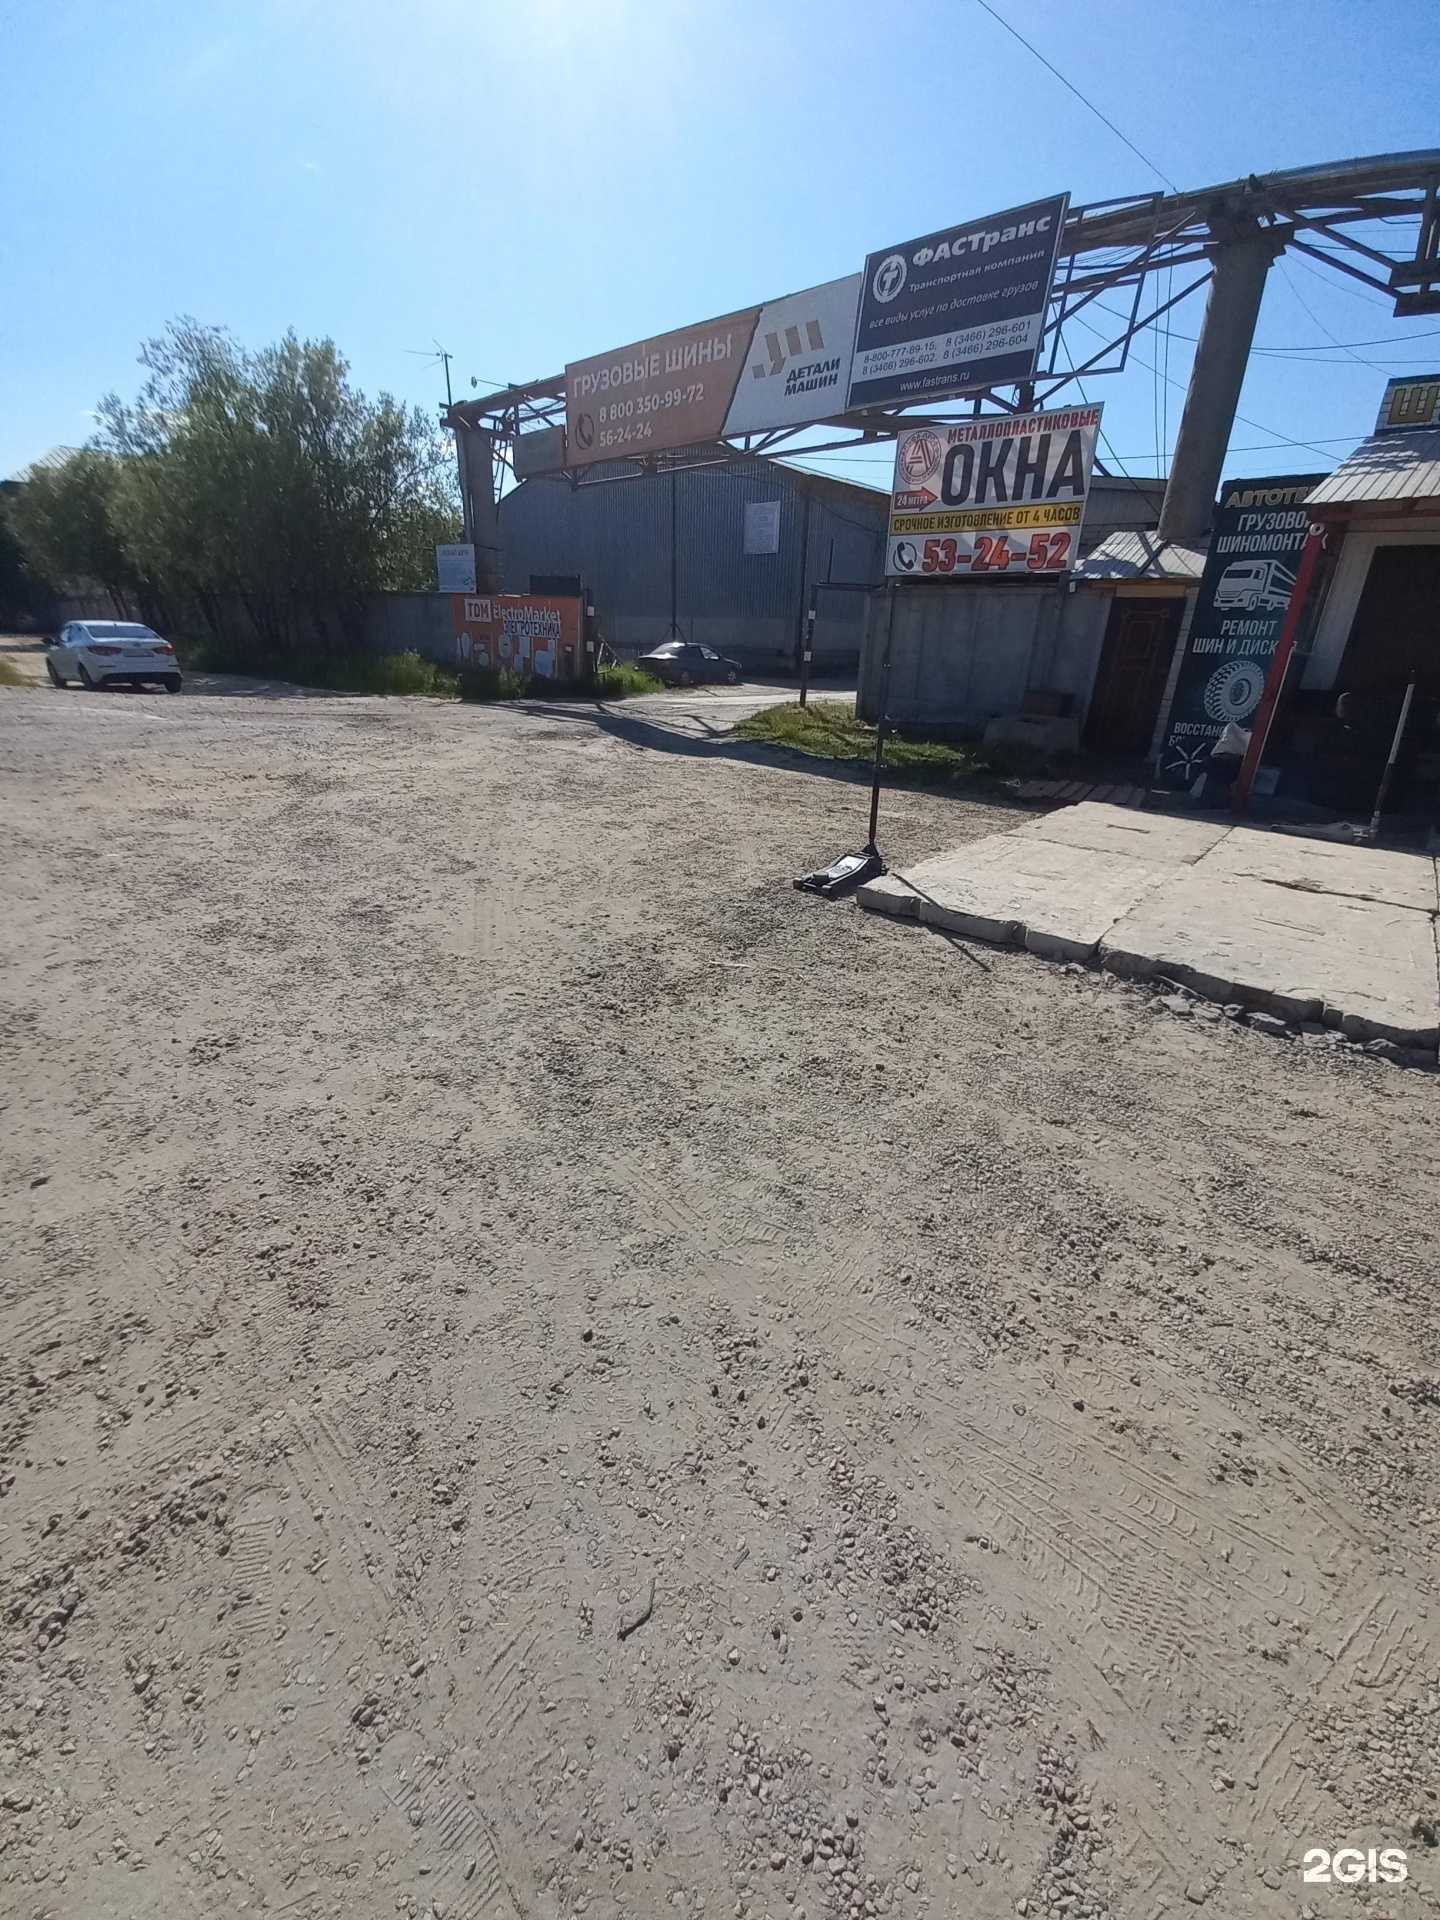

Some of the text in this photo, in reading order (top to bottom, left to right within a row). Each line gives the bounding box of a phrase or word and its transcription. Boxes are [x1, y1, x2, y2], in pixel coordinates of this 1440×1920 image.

[912, 216, 1051, 266] ФАСТранс
[909, 250, 1045, 293] Транспортная компания
[950, 291, 998, 310] доставке
[1001, 280, 1039, 298] грузов
[988, 321, 1031, 338] 296-601
[986, 334, 1028, 351] 296-604
[573, 334, 732, 398] ГРУЗОВЫЕ ШИНЫ
[786, 358, 840, 383] ДЕТАЛИ
[784, 373, 838, 396] МАШИН
[900, 371, 970, 391] www.fastrans.ru
[600, 383, 704, 423] 8 800 350-99-72
[600, 421, 652, 447] 56-24-24
[948, 409, 1099, 443] МЕТАЛЛОПЛАСТИКОВЫЕ
[941, 430, 1086, 506] ОКНА
[1224, 486, 1317, 509] АВТОТЕ
[894, 506, 1080, 531] СРОЧНОЕ ИЗГОТОВЛЕНИЕ ОТ 4 ЧАСОВ
[1237, 511, 1312, 532] ГРУЗОВО
[921, 532, 1072, 573] 53-24-52
[1220, 620, 1279, 636] РЕМОНТ
[1192, 638, 1297, 656] ШИН И ДИСК
